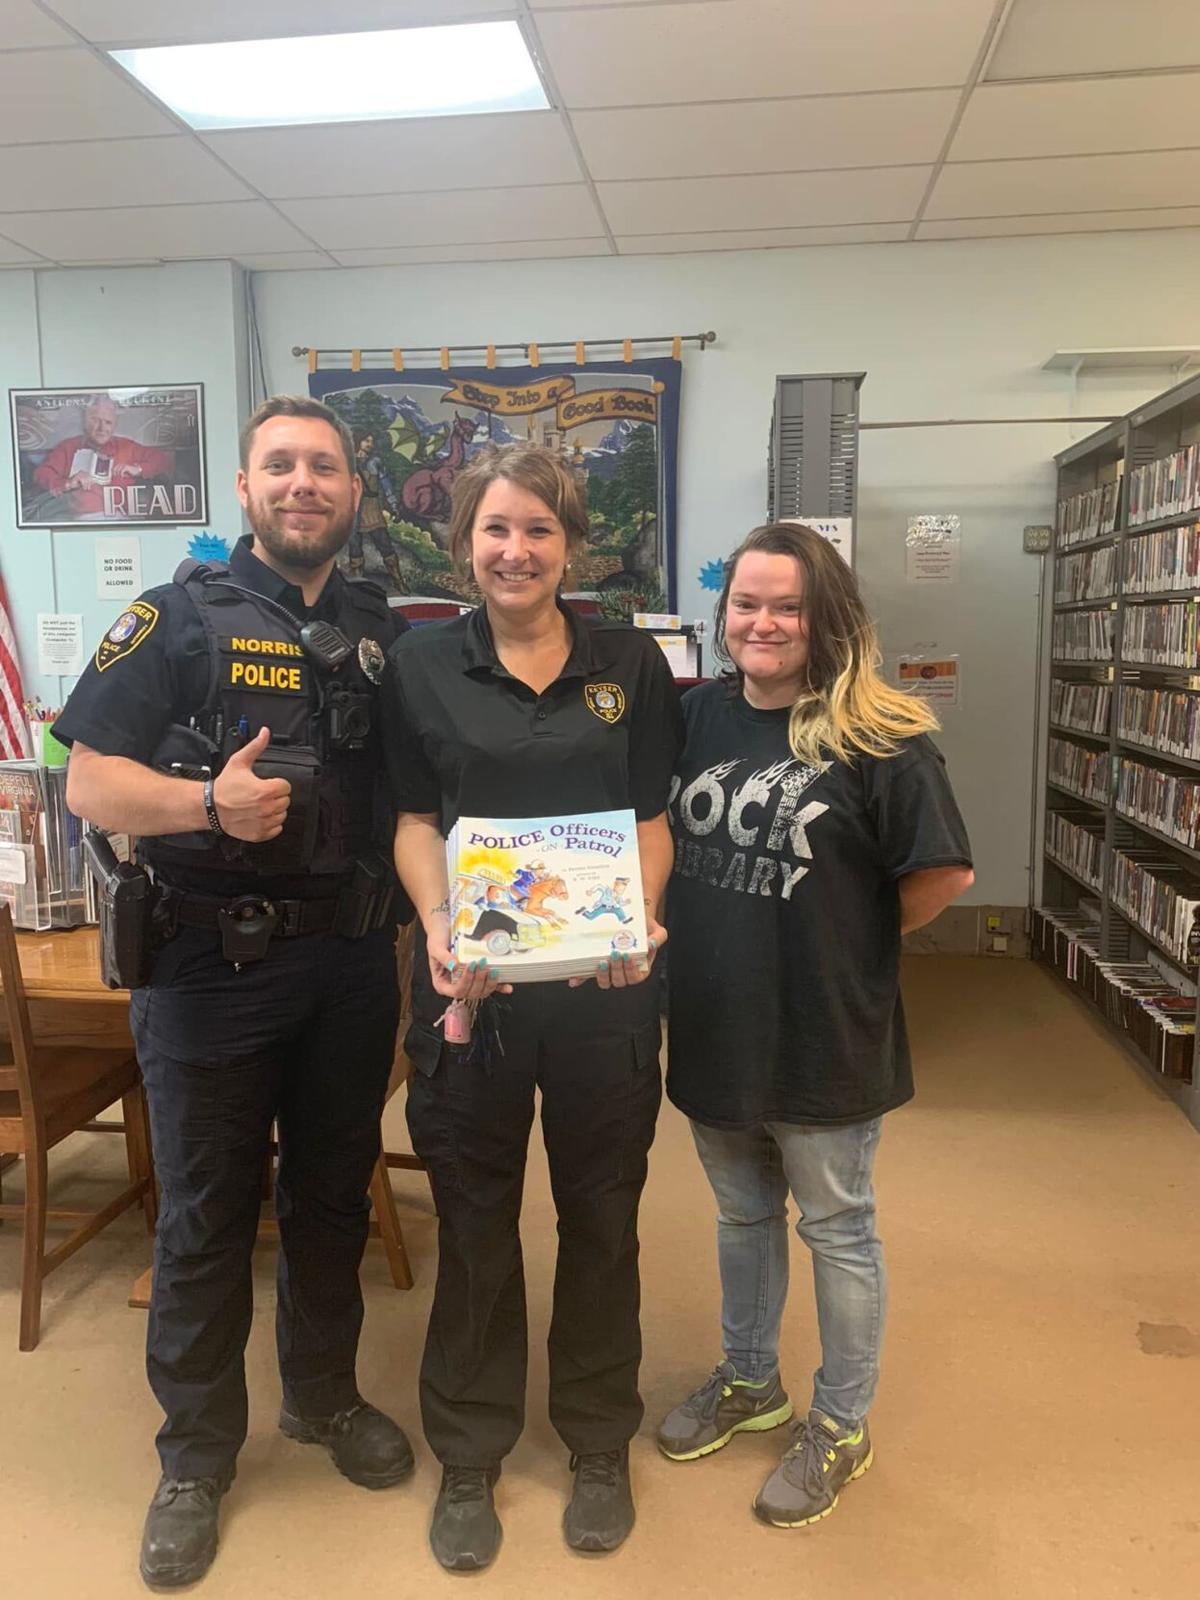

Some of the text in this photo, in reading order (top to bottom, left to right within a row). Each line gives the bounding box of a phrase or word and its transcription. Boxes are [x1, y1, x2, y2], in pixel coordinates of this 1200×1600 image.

[506, 390, 541, 408] Into
[562, 394, 654, 421] Good Book
[103, 484, 197, 517] READ
[696, 621, 704, 634] 4
[230, 662, 302, 690] POLICE
[467, 822, 628, 850] POLICE Officers
[564, 837, 623, 859] Patrol
[673, 837, 810, 901] IBRARY
